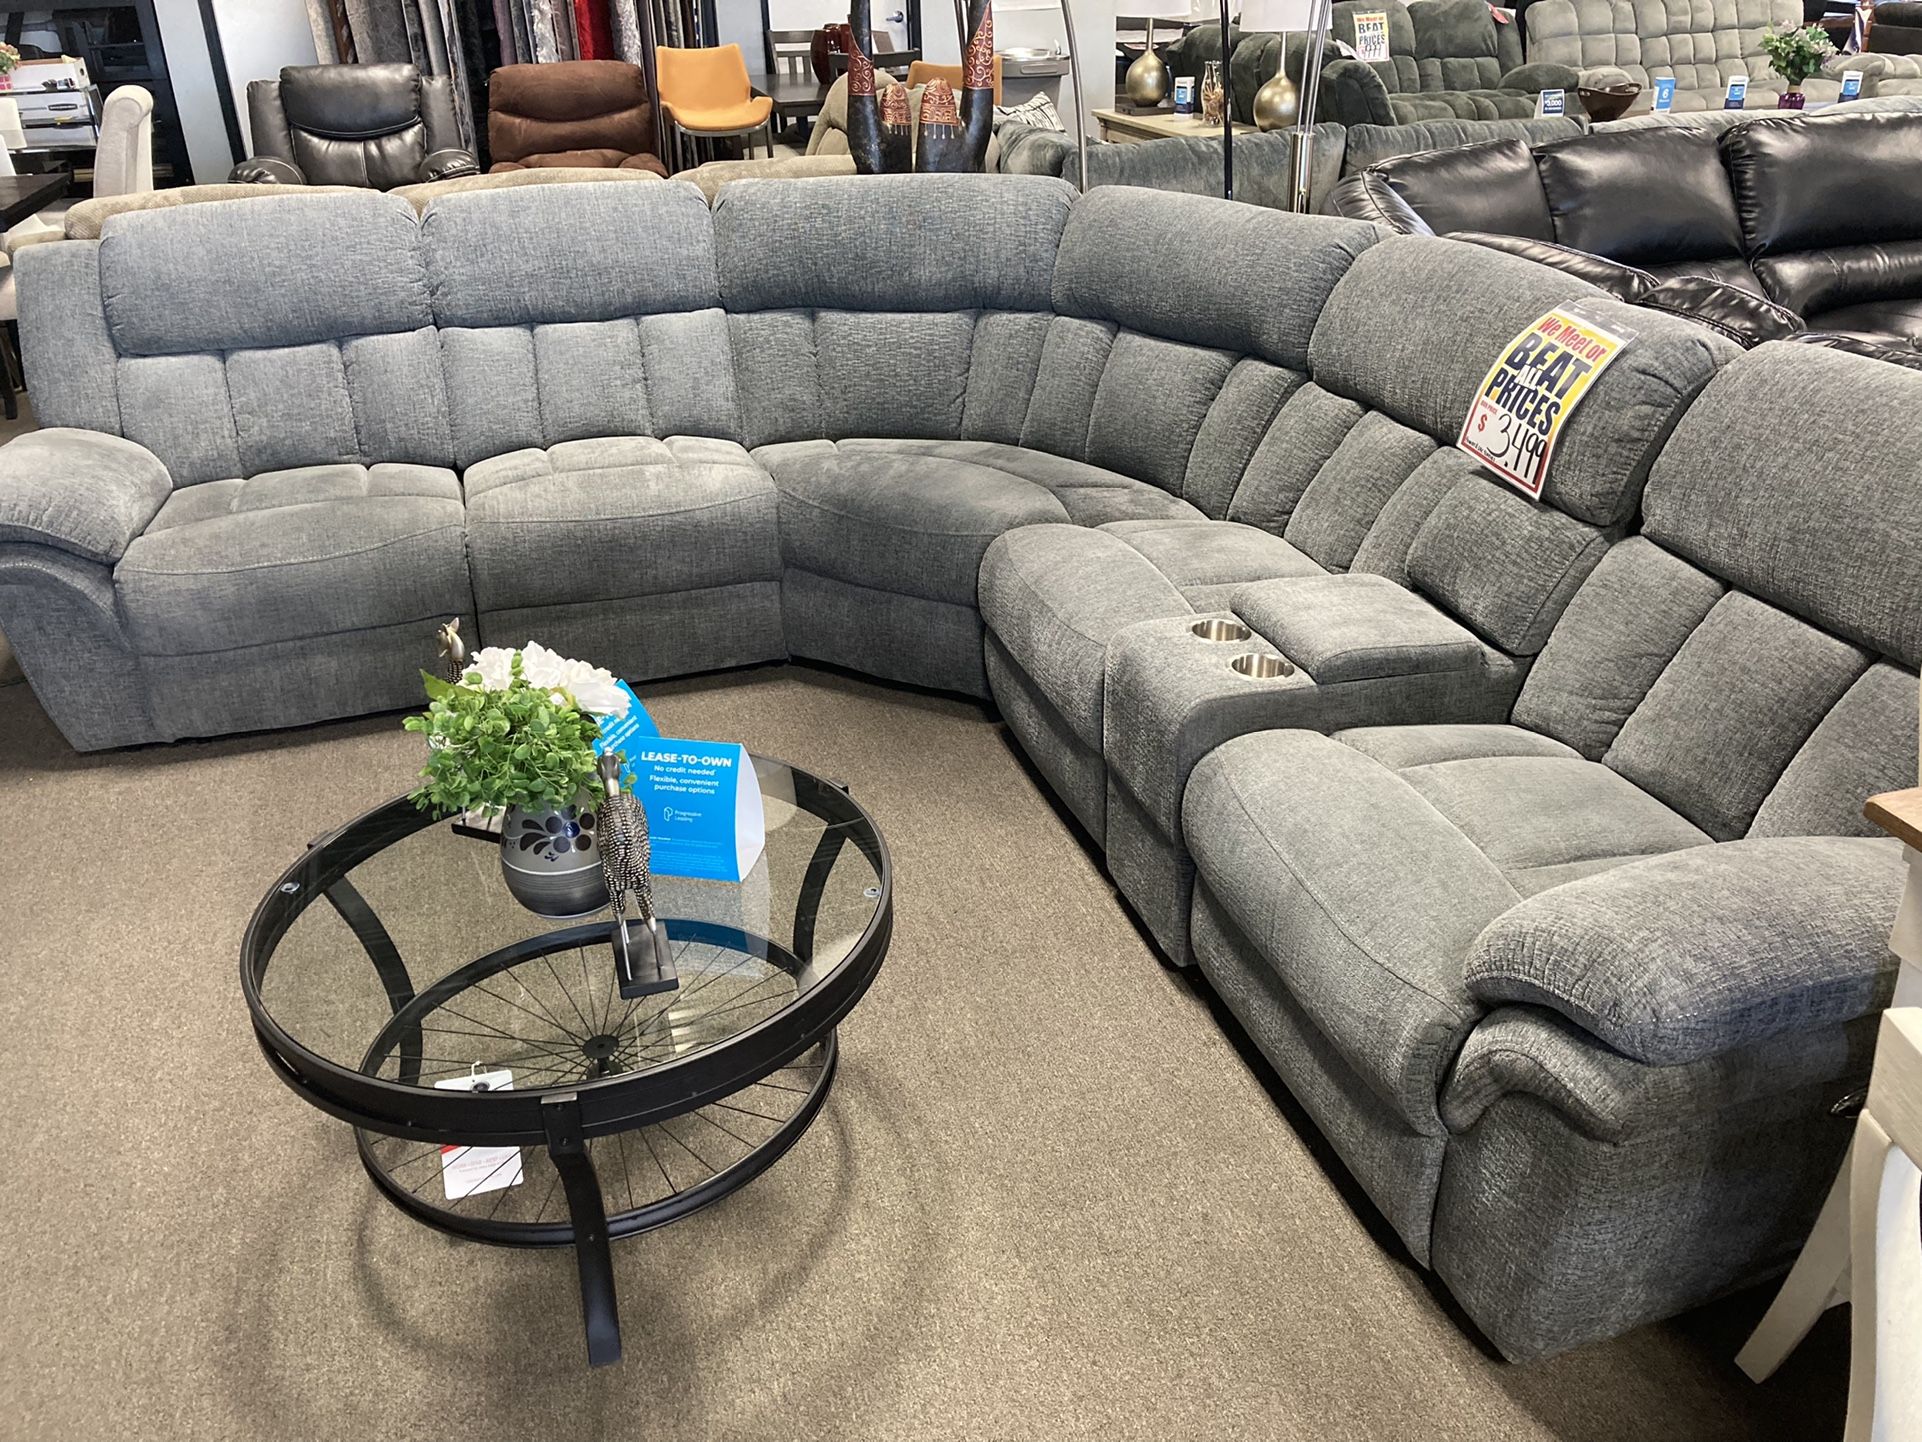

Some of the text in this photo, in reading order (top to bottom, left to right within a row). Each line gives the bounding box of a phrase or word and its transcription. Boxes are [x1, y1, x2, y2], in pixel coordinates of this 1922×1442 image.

[1358, 22, 1384, 34] BEAT
[1359, 34, 1386, 45] PRICES
[1662, 88, 1670, 99] 6
[1537, 316, 1608, 362] We Meet or
[1505, 332, 1592, 400] BEAT
[1514, 364, 1543, 390] ALL
[1485, 367, 1561, 437] PRICES
[1478, 414, 1488, 432] $
[641, 751, 732, 767] LEASE-TO-OWN
[665, 766, 687, 774] credit
[649, 775, 719, 787] Flexible, convenient
[654, 784, 715, 795] purchase options
